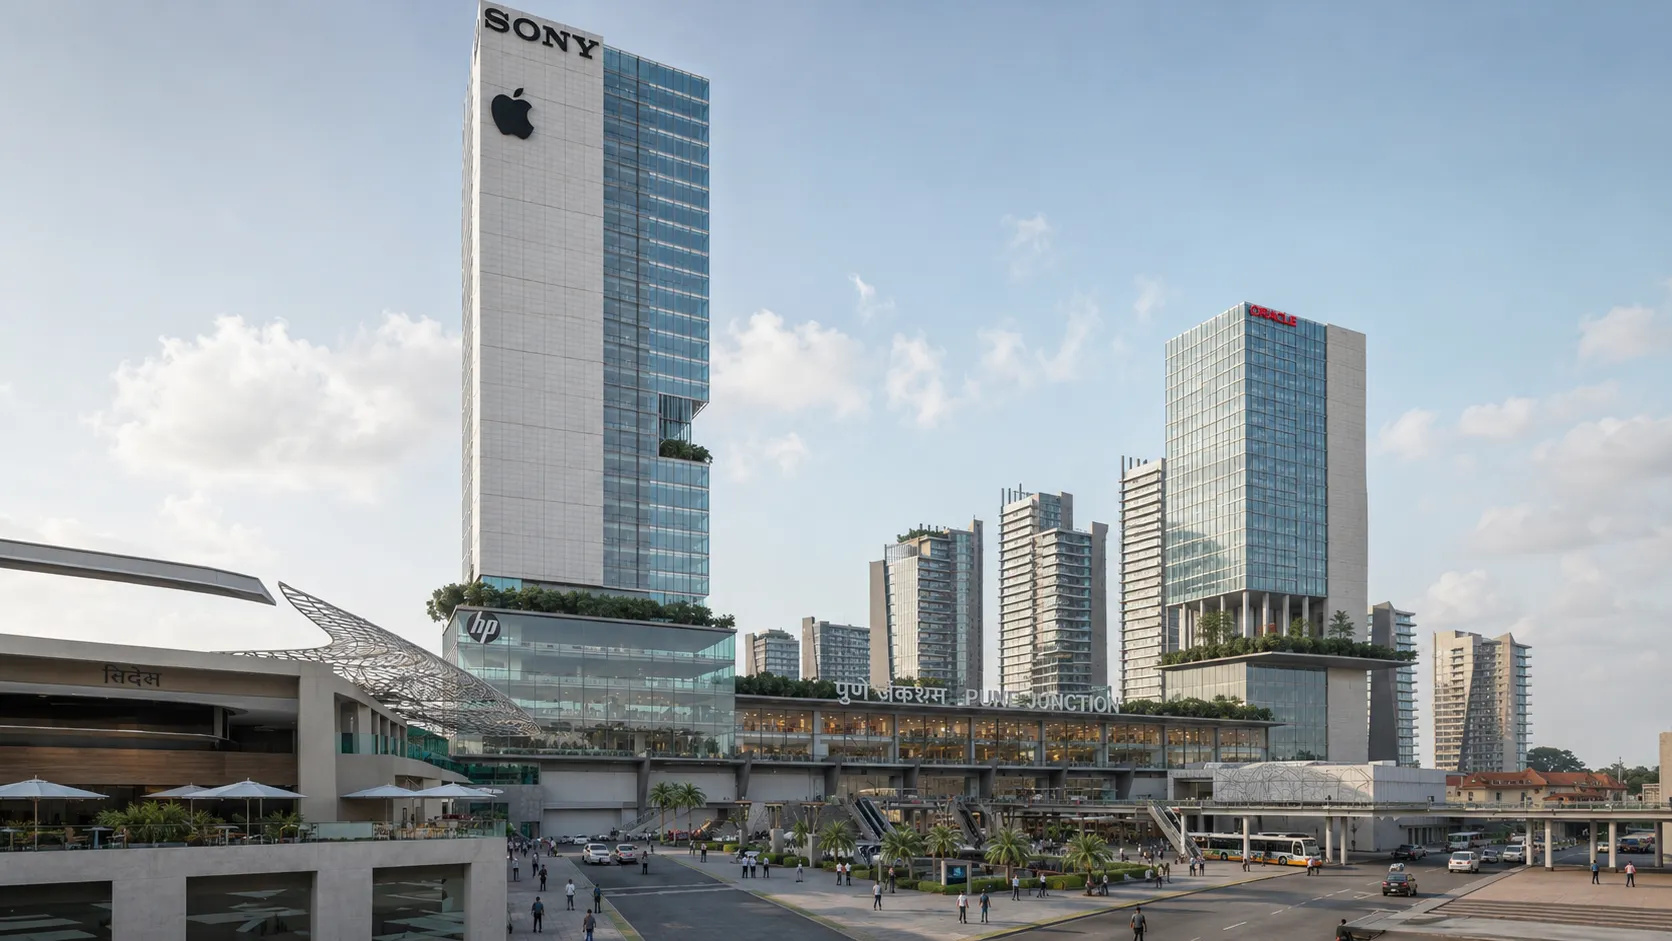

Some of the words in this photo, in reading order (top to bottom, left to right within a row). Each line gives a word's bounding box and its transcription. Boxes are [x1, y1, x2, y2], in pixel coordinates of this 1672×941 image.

[484, 8, 599, 59] SONY
[1249, 304, 1297, 327] ORACLE
[470, 610, 499, 644] hp
[833, 677, 870, 705] पुणे
[965, 689, 1020, 708] PUNE
[1026, 690, 1120, 713] JUNCTION
